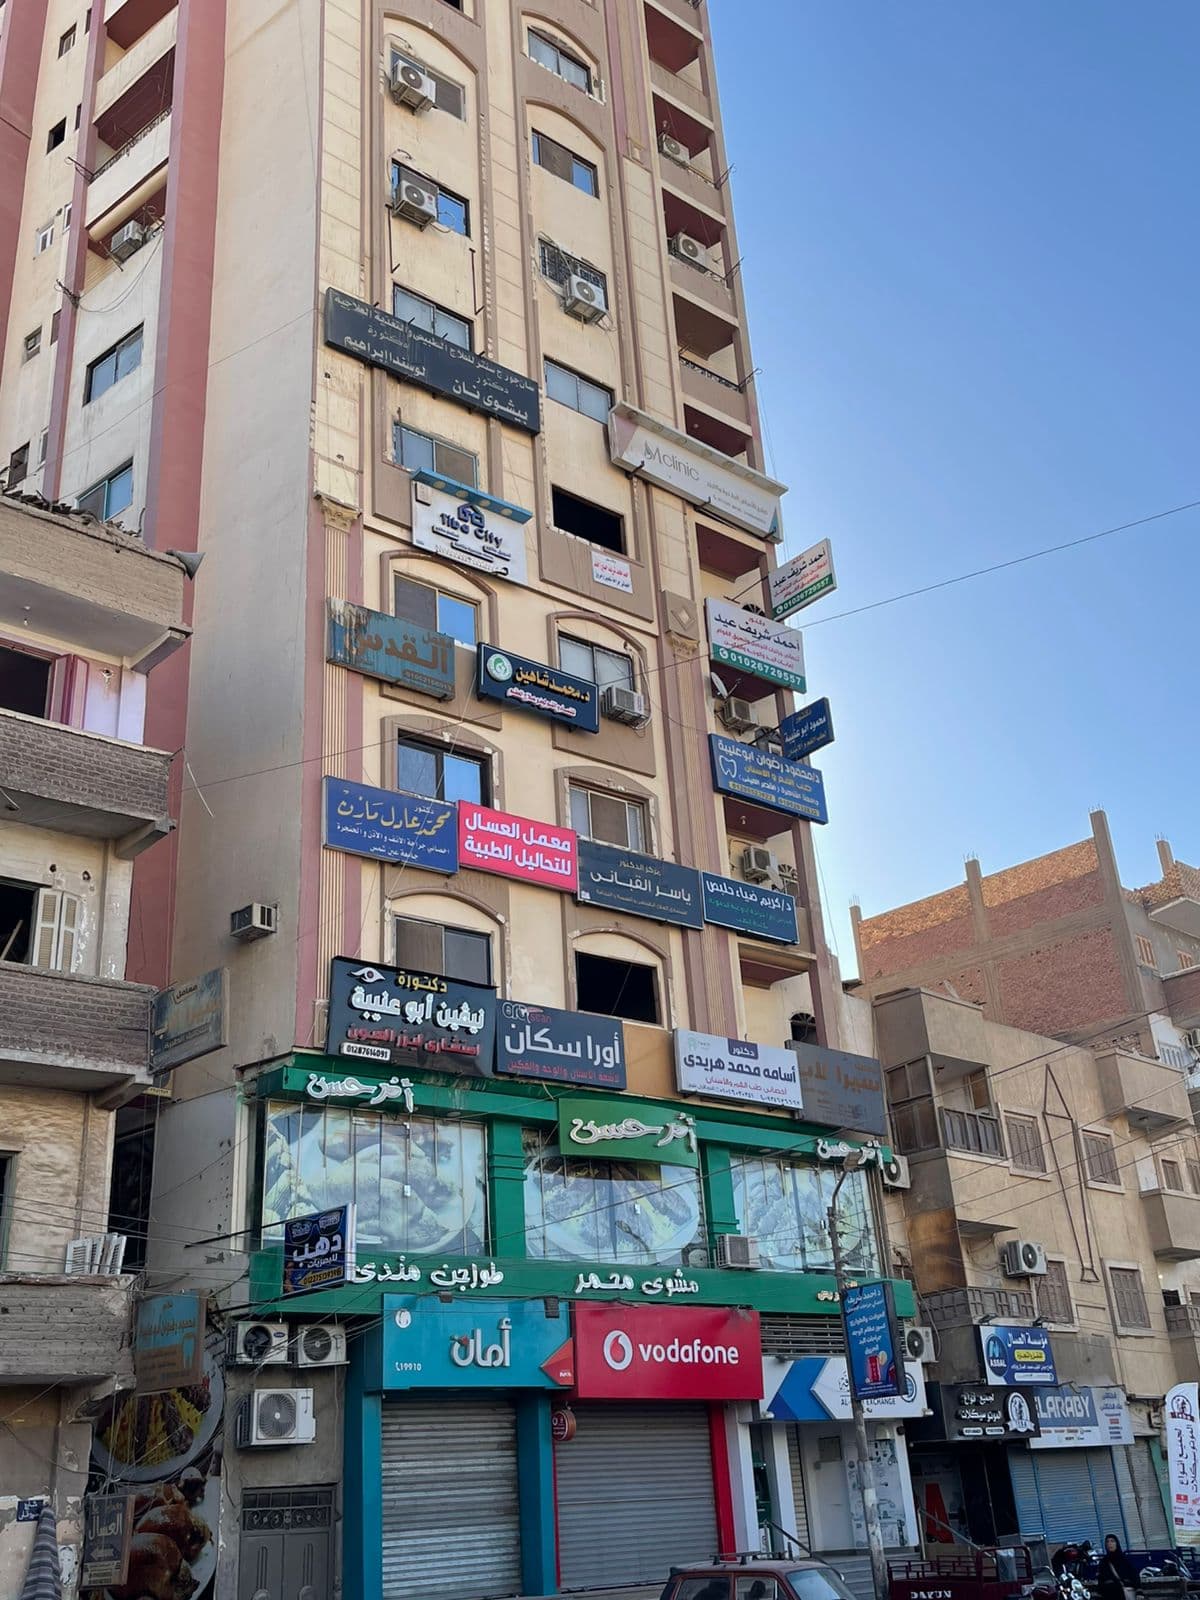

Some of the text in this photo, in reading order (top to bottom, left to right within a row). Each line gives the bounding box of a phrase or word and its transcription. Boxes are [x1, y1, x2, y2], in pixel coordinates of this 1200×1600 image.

[474, 526, 504, 549] City
[713, 612, 737, 629] عيد
[739, 620, 772, 642] شريف
[514, 665, 550, 688] شاهين
[729, 651, 802, 687] 01026729557
[380, 805, 421, 830] عادل
[413, 805, 435, 815] دكتور
[464, 811, 572, 853] معمل العسال
[463, 834, 572, 877] للتحاليل الطبية
[655, 884, 692, 906] ياسر
[735, 886, 759, 903] ضياء
[397, 971, 448, 993] دكتورة
[404, 992, 435, 1025] أبو
[346, 1024, 394, 1044] العيون
[393, 1029, 424, 1048] ليزر
[504, 1022, 621, 1069] أورا سكان
[731, 1046, 755, 1057] دكتور
[727, 1060, 761, 1077] محمد
[292, 1233, 342, 1269] دهب
[429, 1261, 505, 1292] طواجن
[574, 1271, 636, 1295] محمر
[450, 1317, 513, 1367] أمان
[638, 1337, 740, 1365] vodafone
[400, 1361, 423, 1372] 19910
[866, 1398, 897, 1406] EXCHANGE
